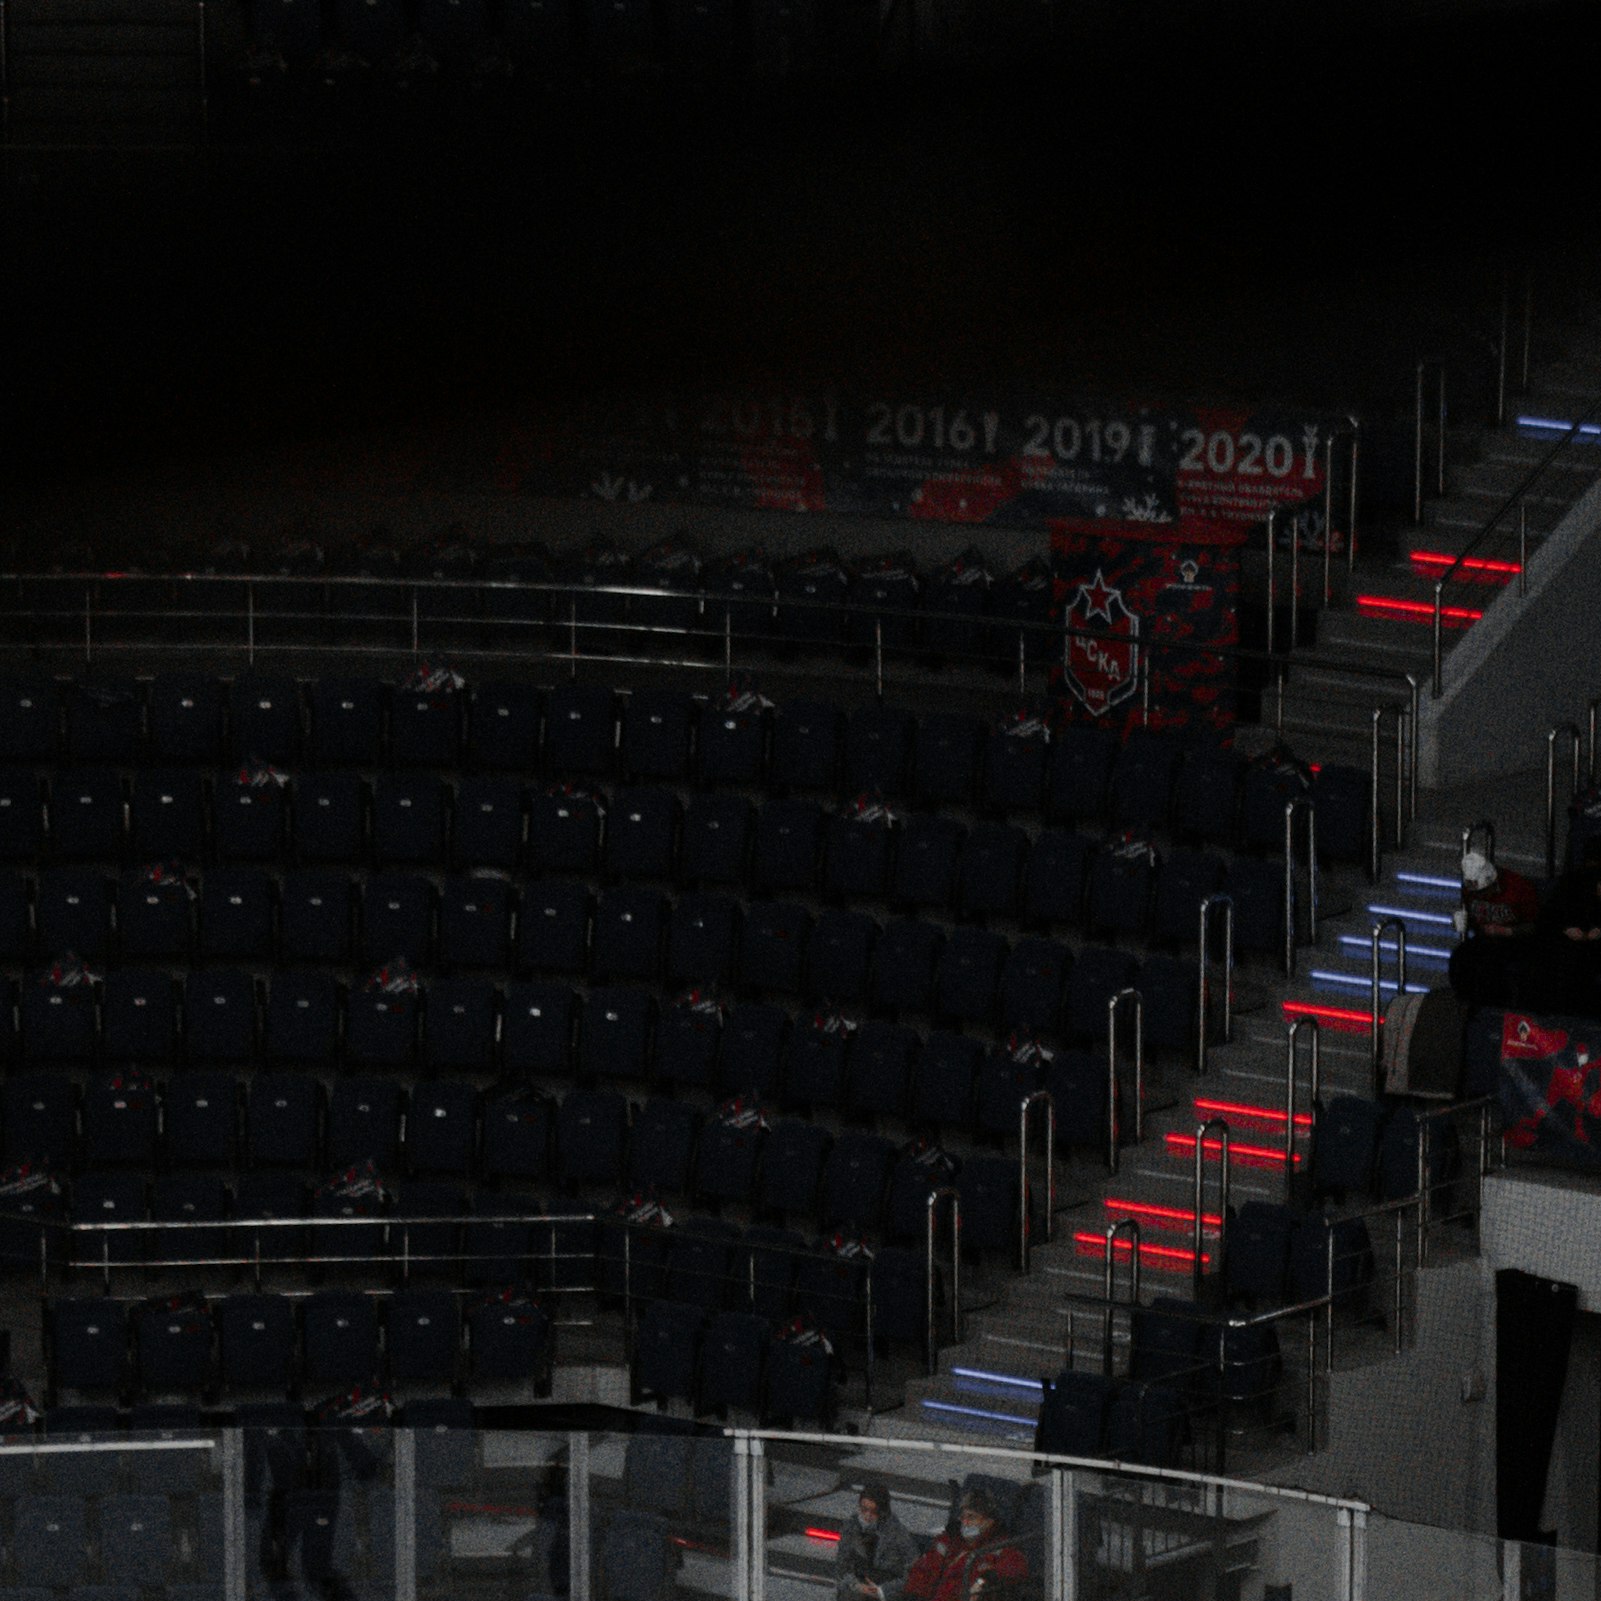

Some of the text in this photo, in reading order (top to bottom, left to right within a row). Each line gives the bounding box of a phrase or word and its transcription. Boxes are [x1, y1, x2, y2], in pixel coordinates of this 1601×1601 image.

[866, 400, 975, 450] 2016
[1021, 413, 1132, 464] 2019
[1178, 426, 1294, 478] 2020
